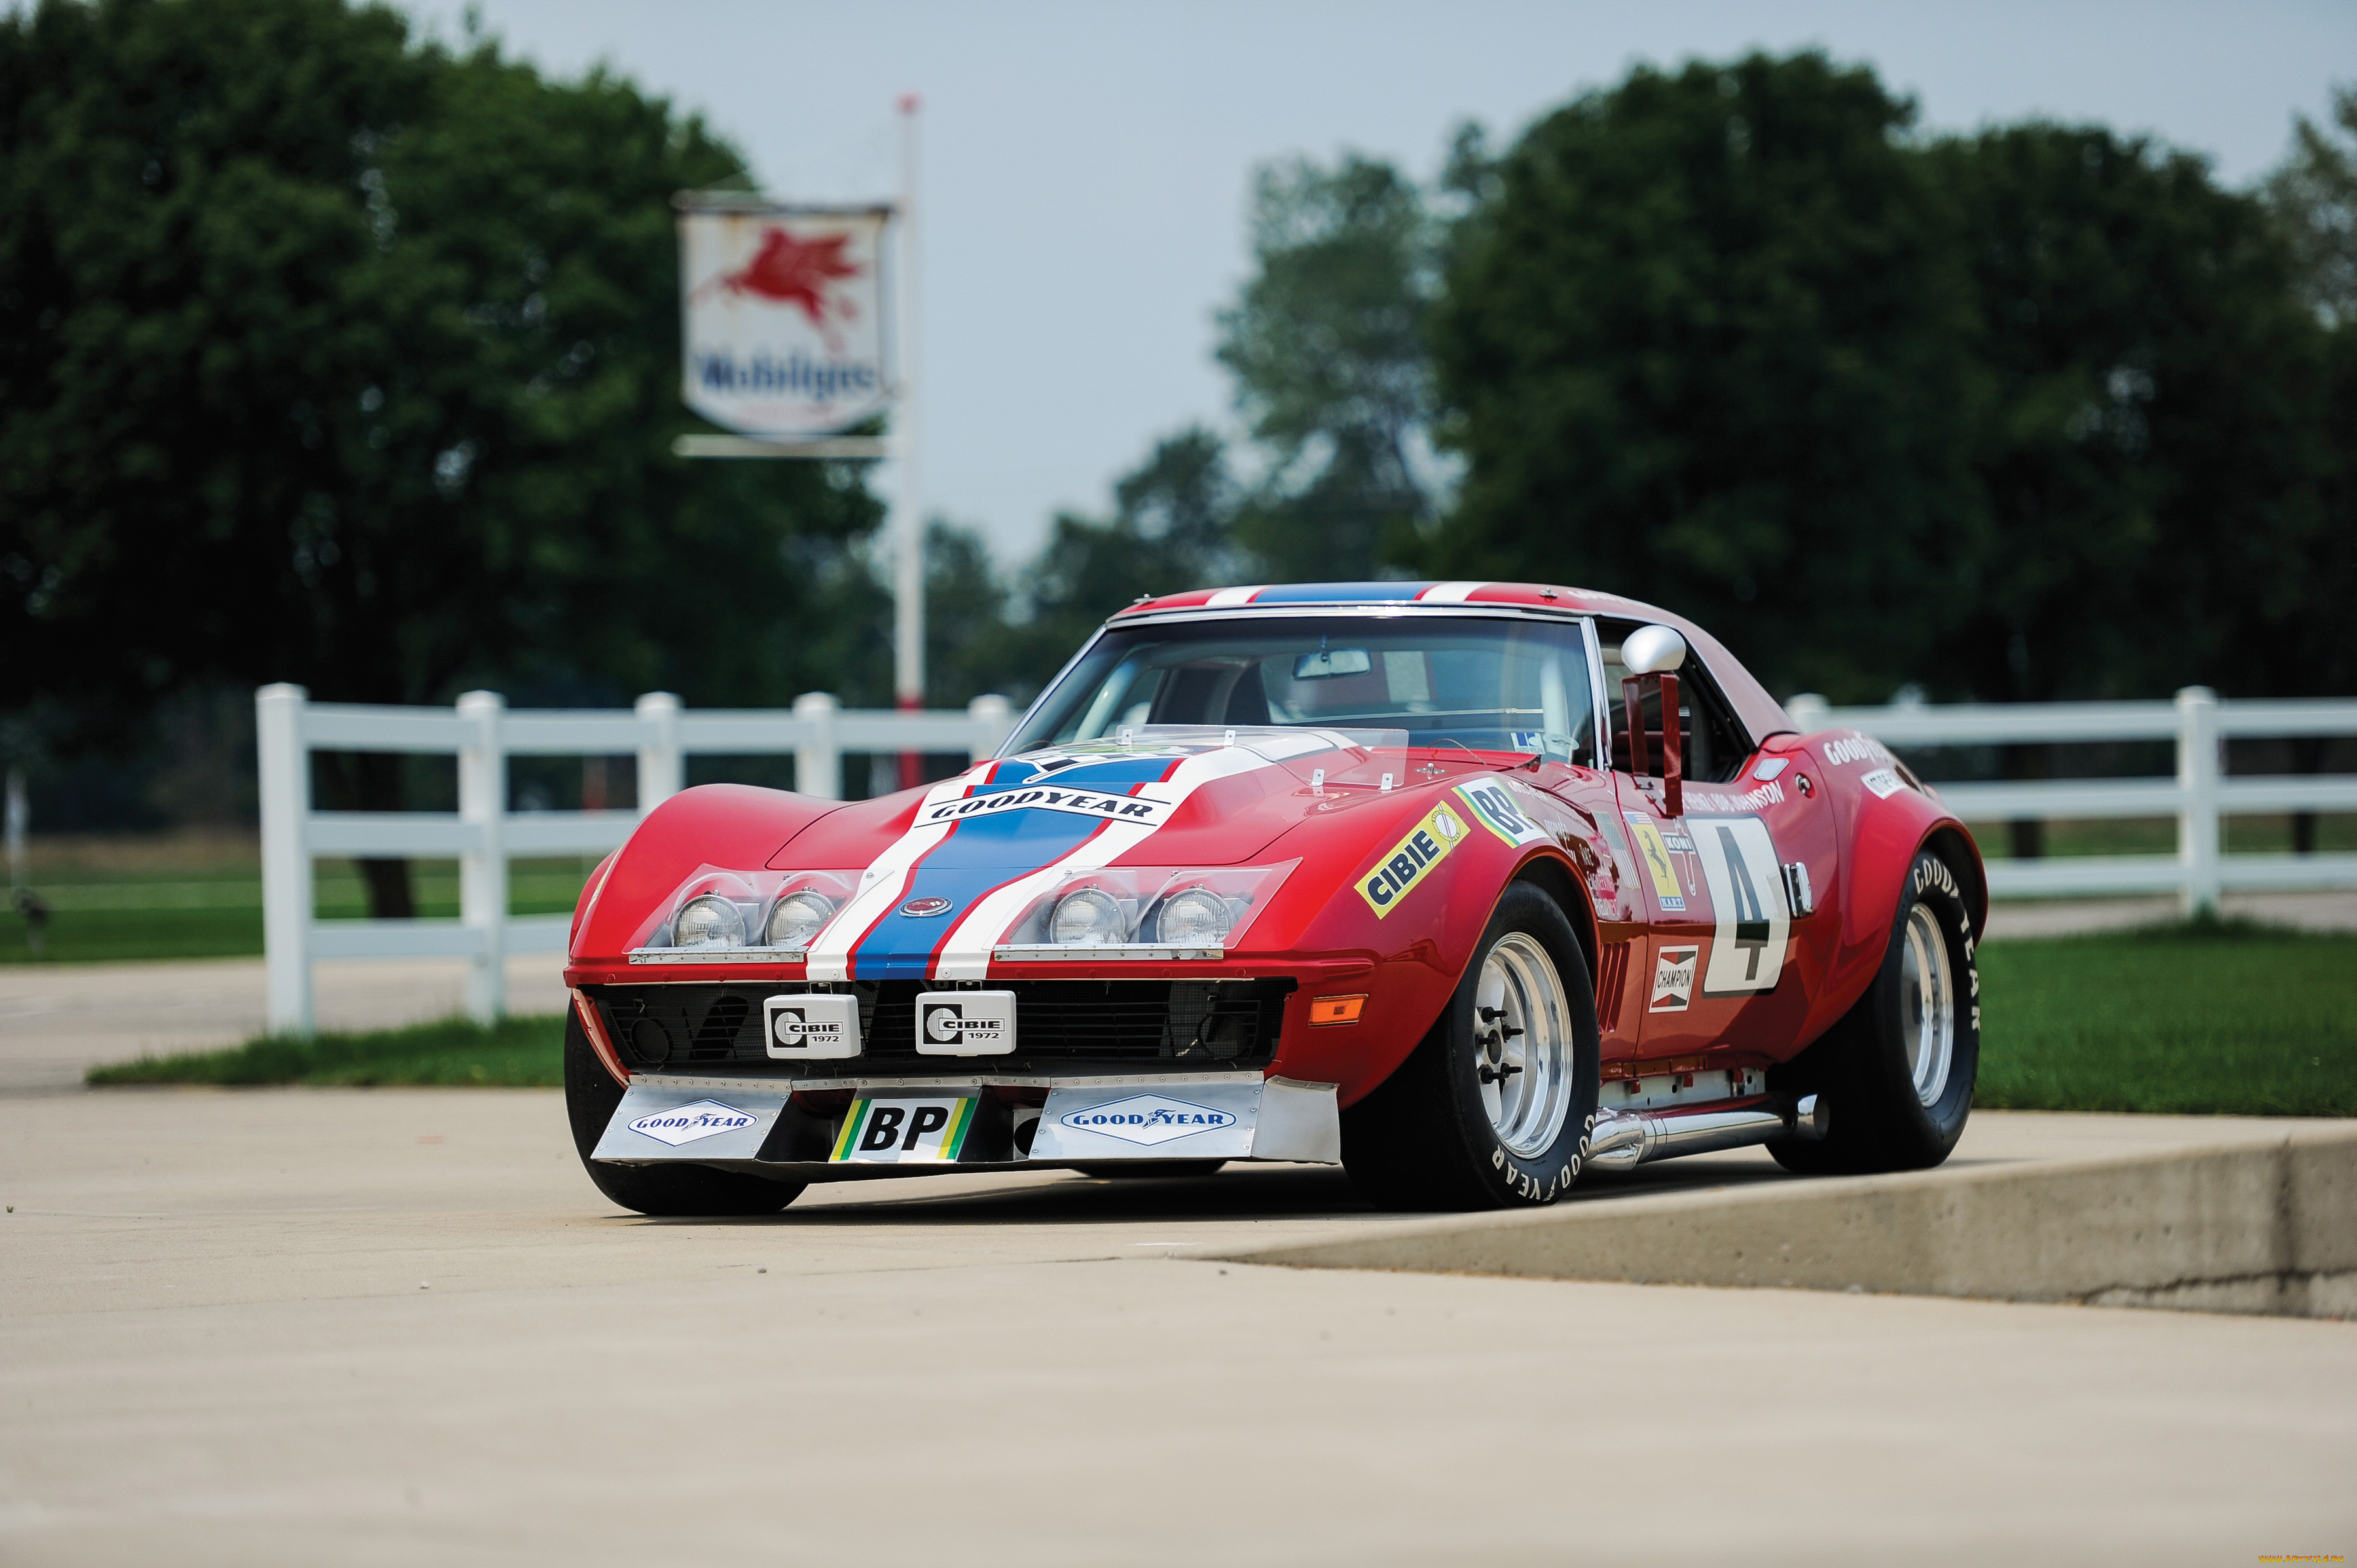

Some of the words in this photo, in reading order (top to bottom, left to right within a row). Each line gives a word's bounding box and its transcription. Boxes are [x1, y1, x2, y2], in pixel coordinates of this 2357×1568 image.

[931, 791, 1154, 818] GOODYEAR
[1471, 786, 1535, 835] BP
[1665, 837, 1693, 850] KONI
[1366, 830, 1440, 905] CIBIE
[1715, 826, 1770, 981] 4
[1657, 969, 1692, 989] CHAMPION
[789, 1024, 840, 1032] CIBIE
[943, 1020, 1001, 1029] CIBIE
[859, 1106, 949, 1151] BP
